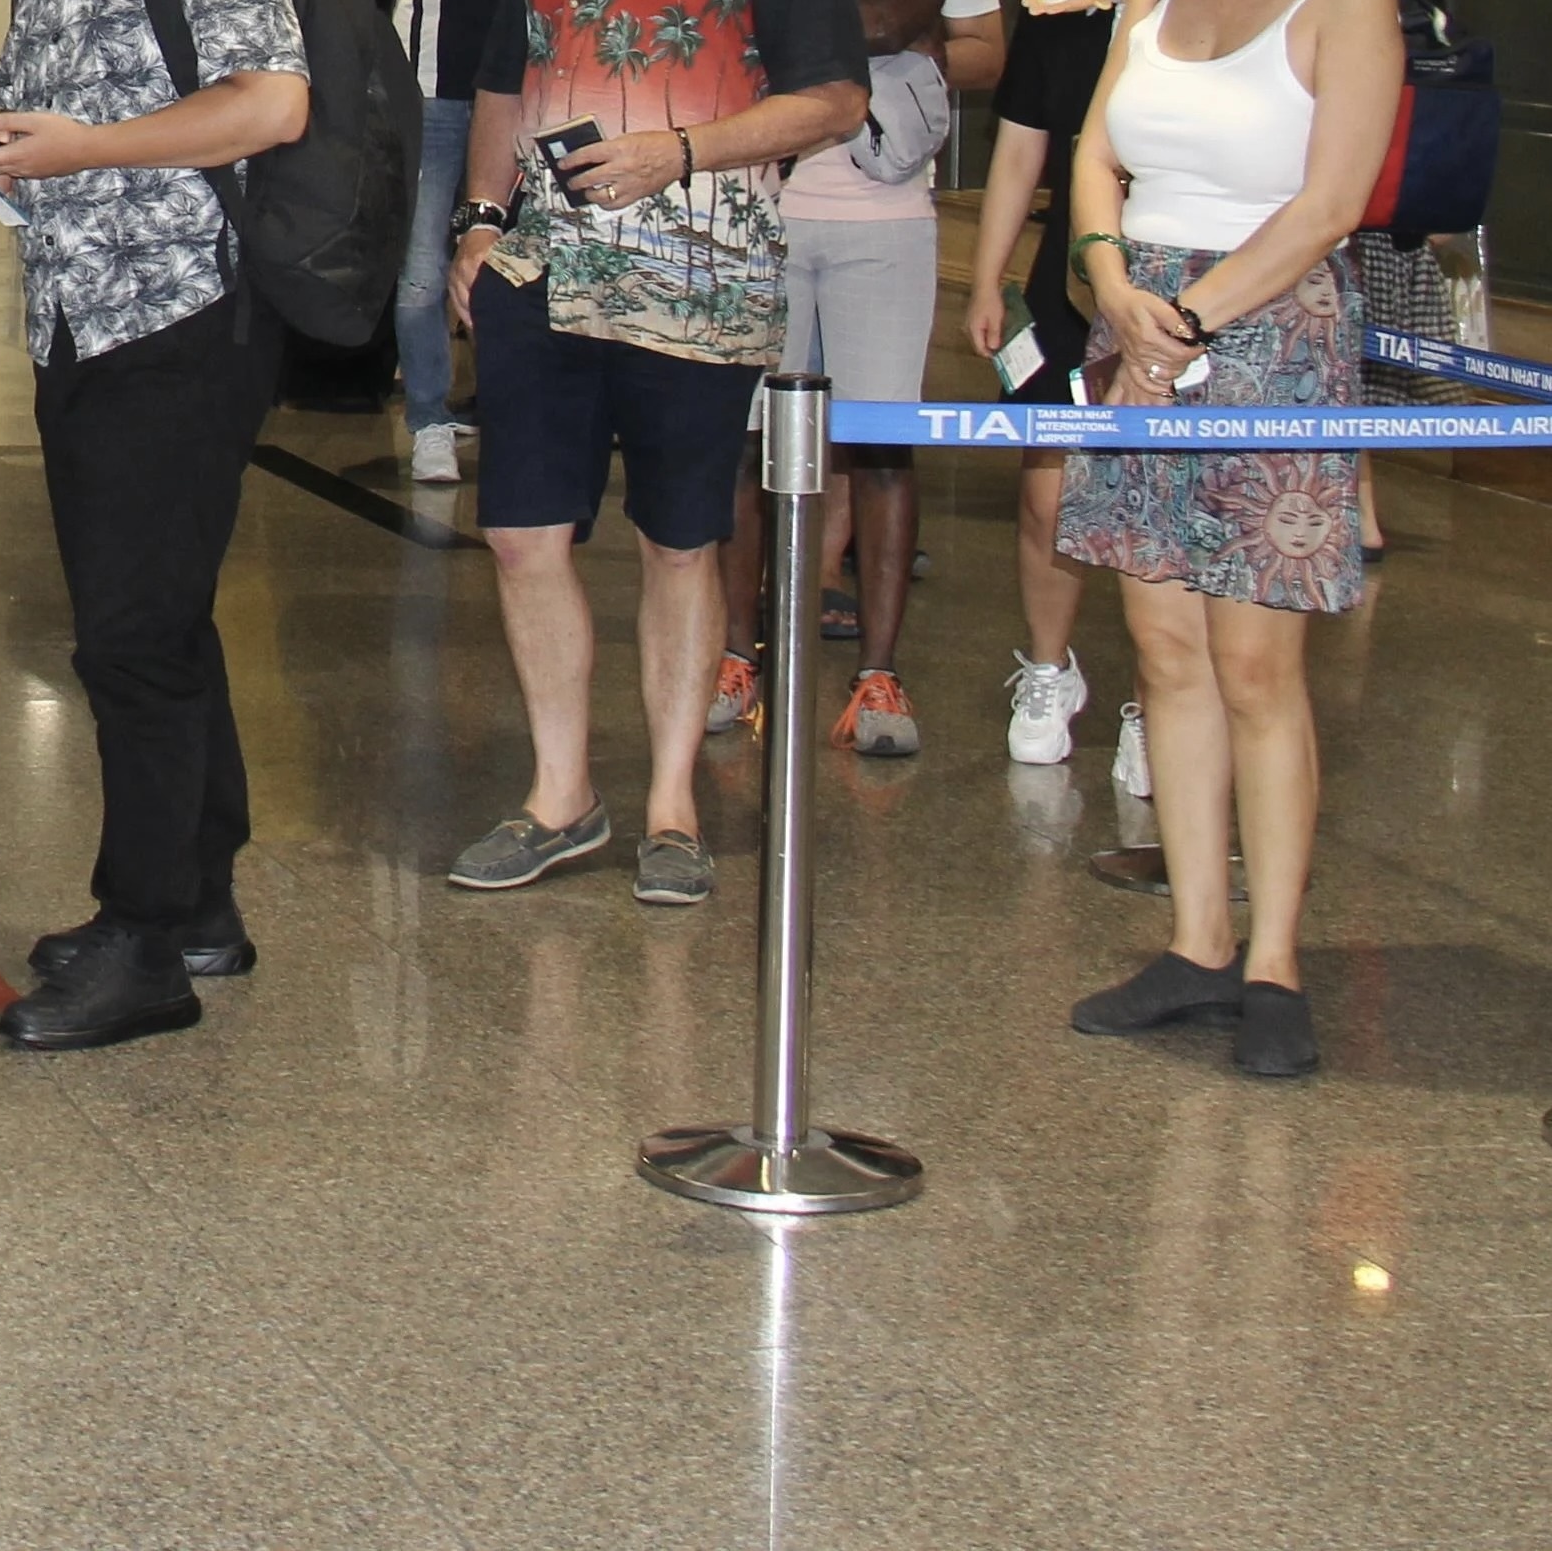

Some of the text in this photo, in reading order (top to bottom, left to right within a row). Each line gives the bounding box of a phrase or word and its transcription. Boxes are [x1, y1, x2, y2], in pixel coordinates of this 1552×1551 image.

[1375, 331, 1414, 364] TIA
[1464, 356, 1486, 376] TAN
[1486, 362, 1509, 381] SON
[1511, 367, 1540, 388] NHAT
[917, 409, 1023, 441] TIA
[1035, 409, 1114, 420] TAN SON NHAT
[1035, 421, 1121, 433] INTERNATIONAL
[1145, 418, 1191, 437] TAN
[1198, 418, 1247, 438] SON
[1253, 418, 1316, 438] NHAT
[1322, 417, 1506, 438] INTERNATIONAL
[1035, 433, 1084, 444] AIRPORT
